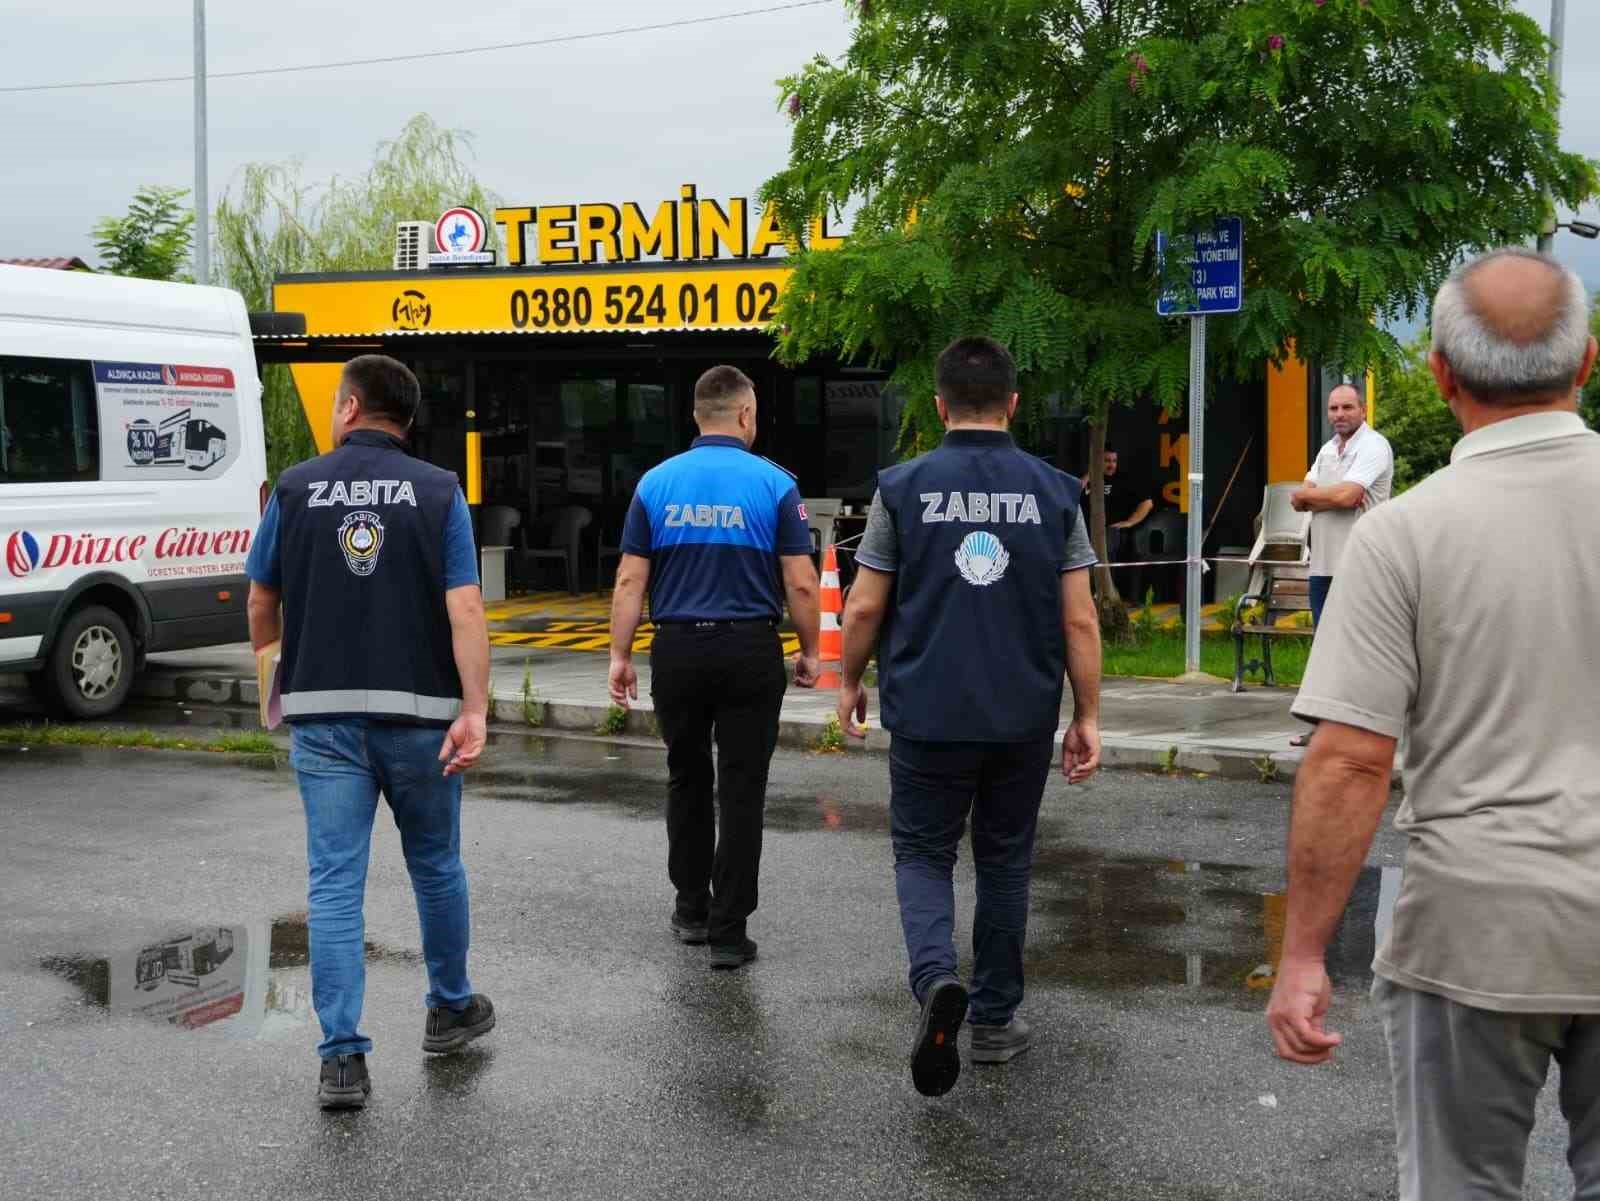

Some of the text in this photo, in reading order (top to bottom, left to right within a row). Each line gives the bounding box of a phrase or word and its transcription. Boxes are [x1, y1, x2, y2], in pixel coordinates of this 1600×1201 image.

[510, 281, 779, 328] 0380 524 01 02
[1197, 287, 1218, 300] PARK
[1219, 284, 1237, 299] YERİ
[143, 431, 155, 448] 10
[308, 480, 417, 508] ZABITA
[919, 491, 1042, 525] ZABITA
[665, 504, 746, 529] ZABITA
[41, 526, 251, 569] Düzce Güven
